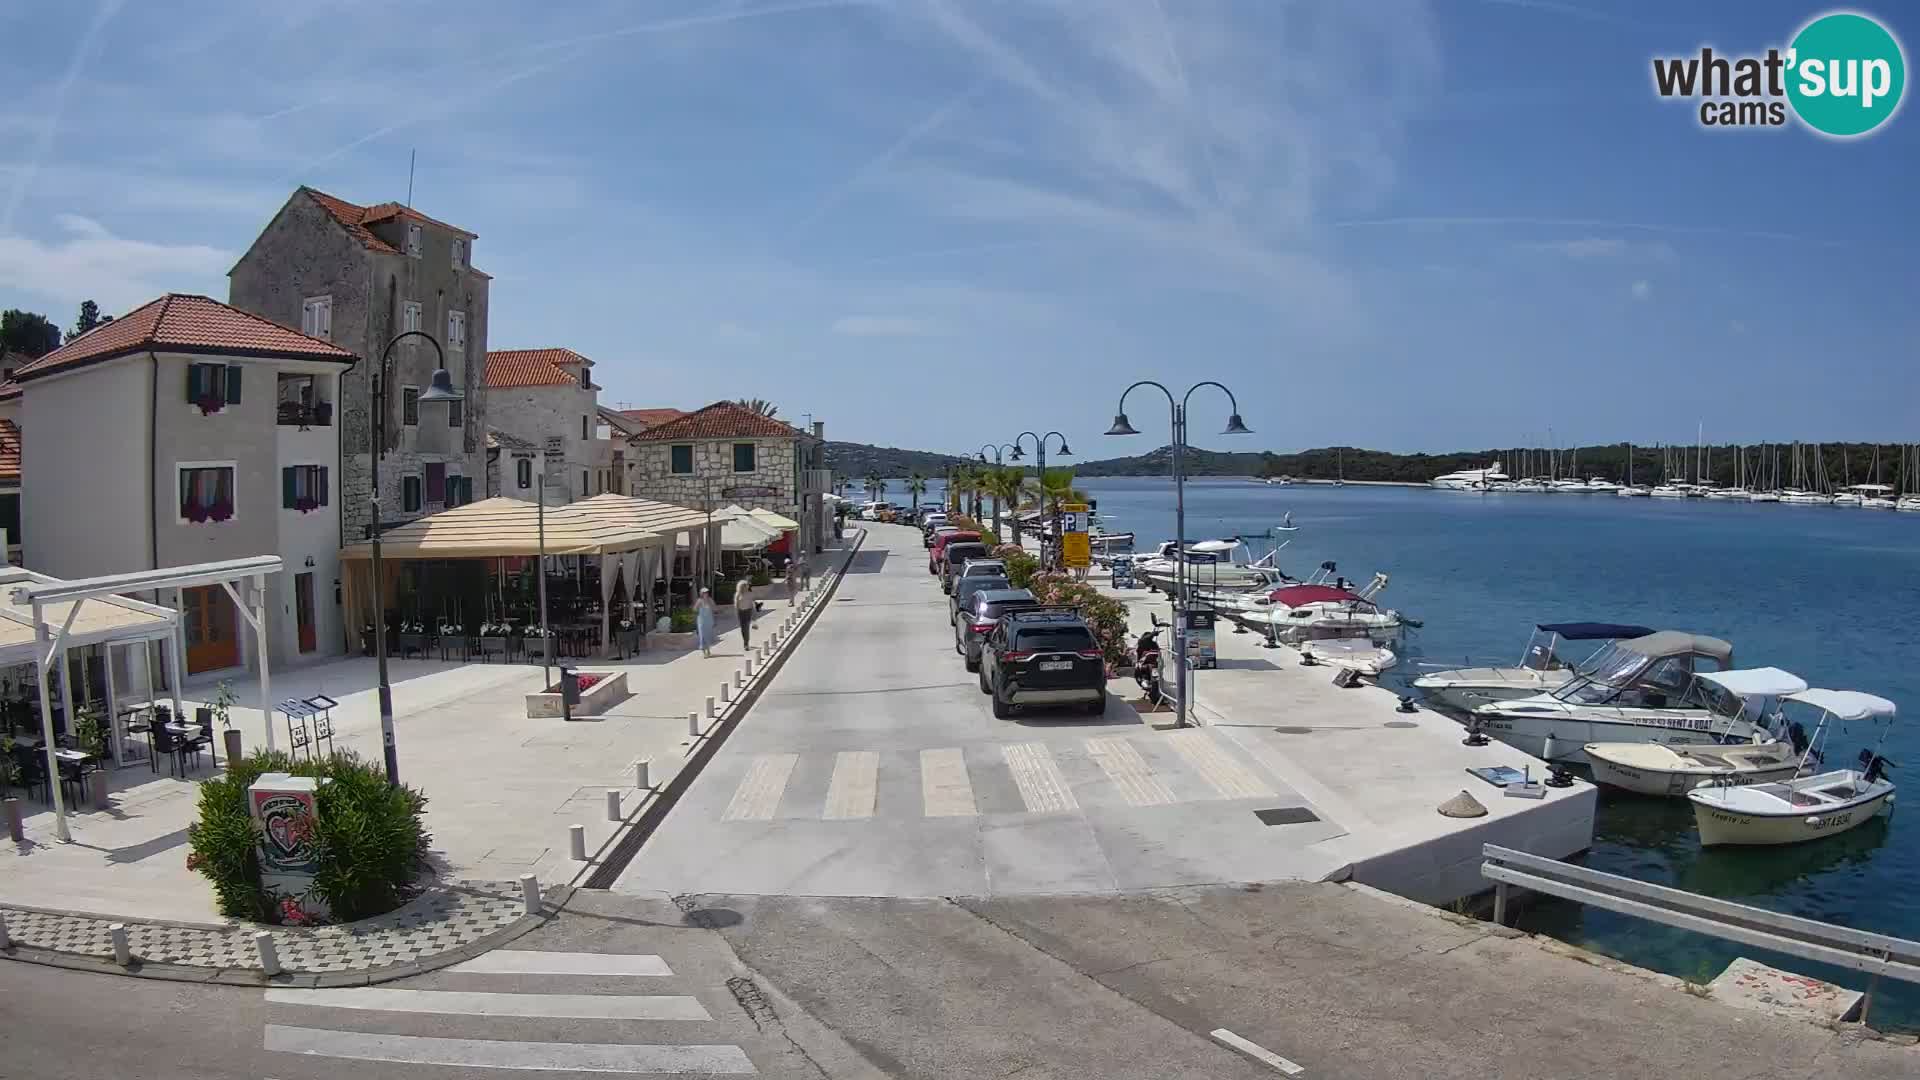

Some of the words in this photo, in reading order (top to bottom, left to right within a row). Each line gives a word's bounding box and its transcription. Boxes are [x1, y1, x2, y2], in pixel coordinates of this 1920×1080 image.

[1065, 514, 1076, 530] P
[1667, 718, 1687, 729] RENT
[1694, 719, 1713, 730] BOAT
